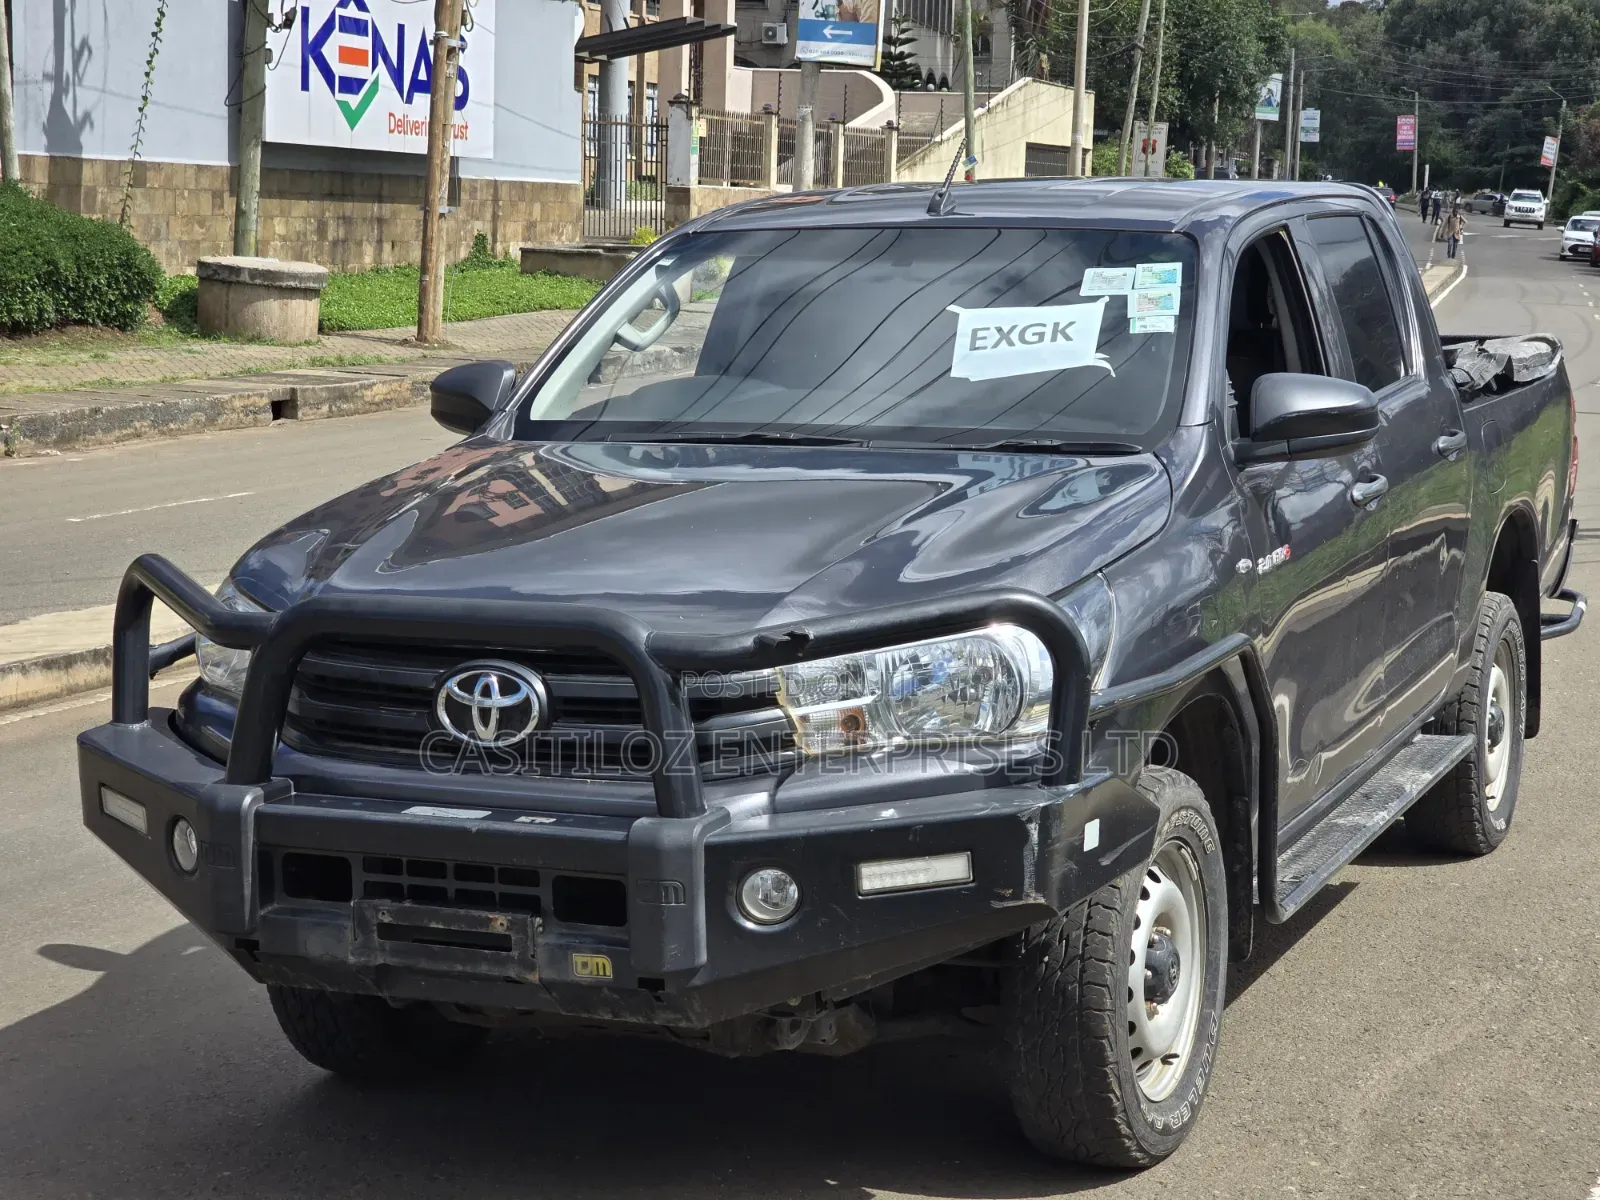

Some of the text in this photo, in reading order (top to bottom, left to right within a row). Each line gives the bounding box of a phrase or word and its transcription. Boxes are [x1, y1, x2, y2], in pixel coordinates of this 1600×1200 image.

[388, 112, 429, 137] Deliveri
[968, 320, 1076, 351] EXGK
[1170, 1011, 1219, 1129] DUELER
